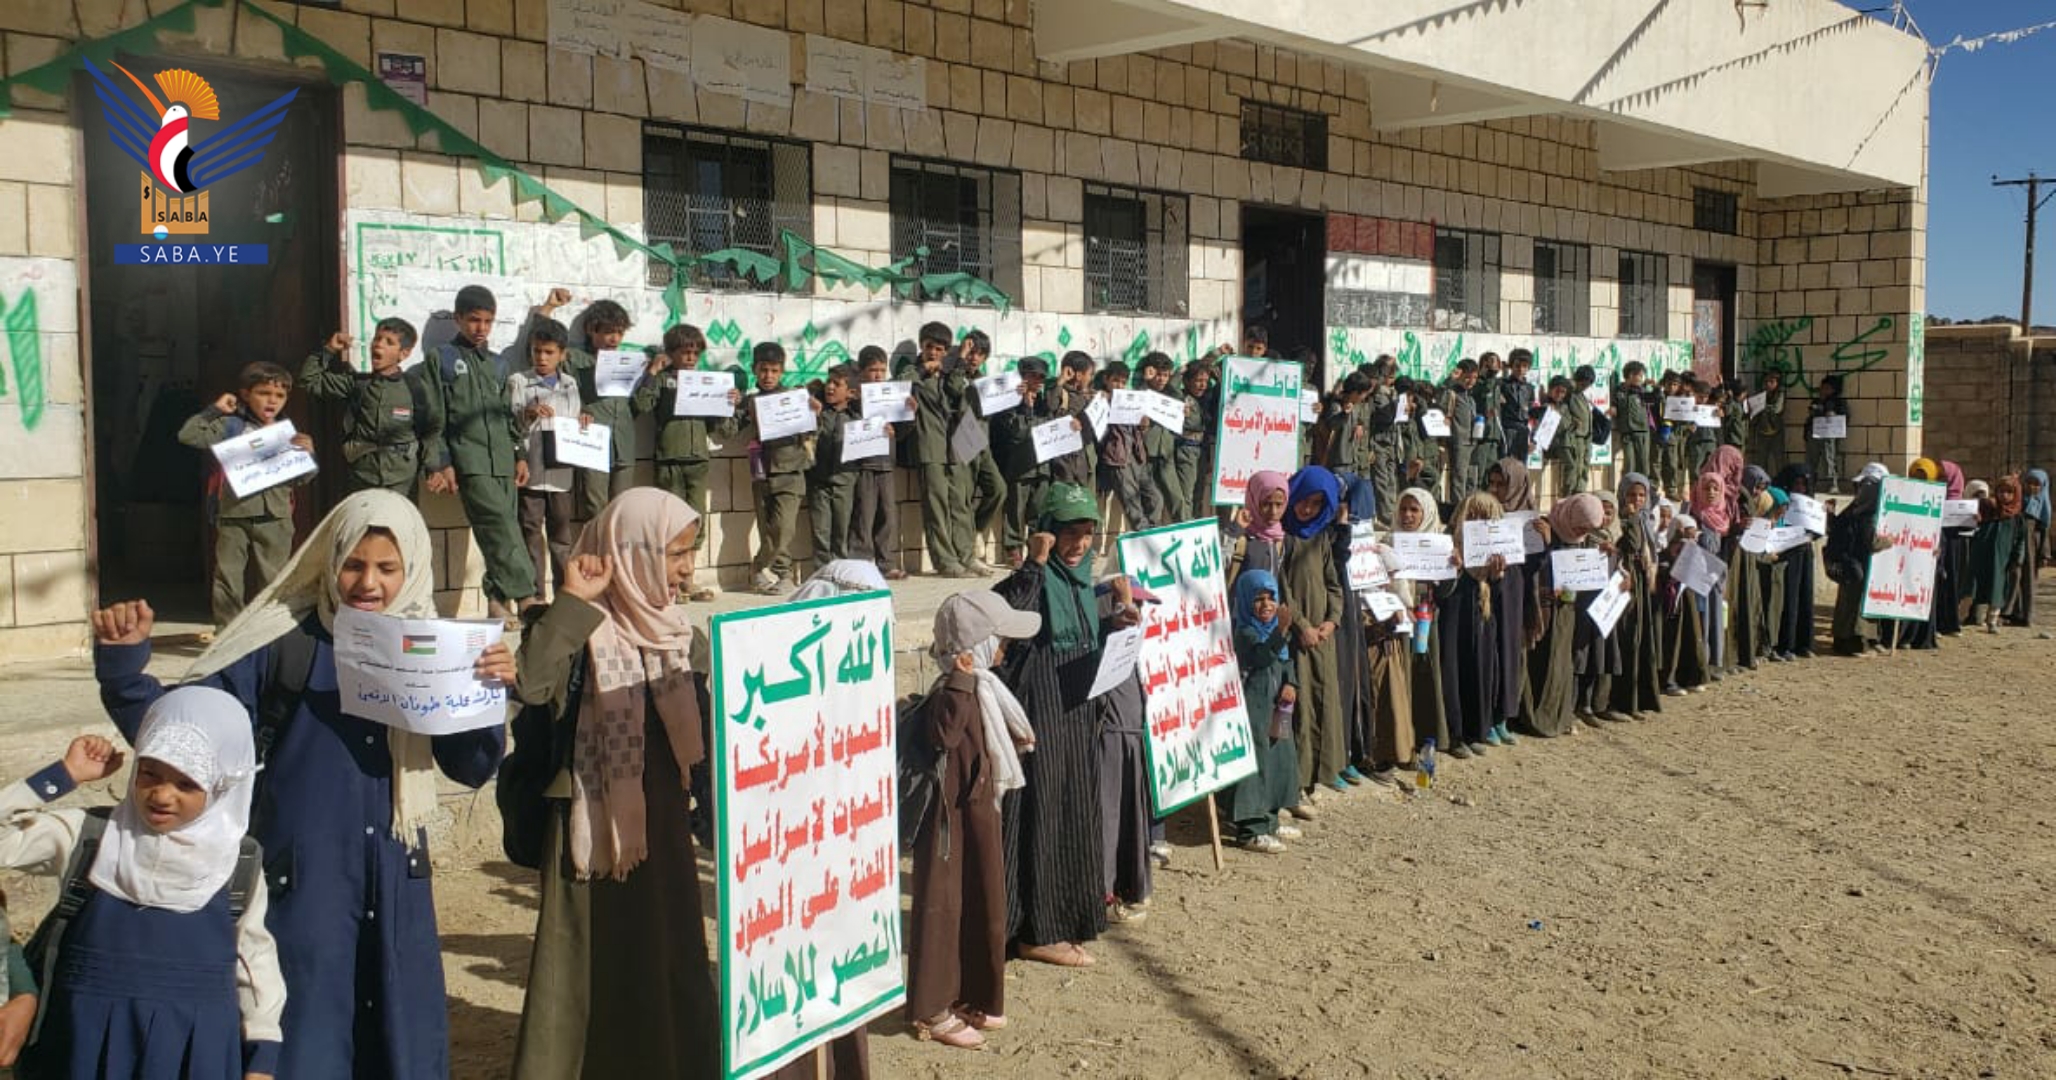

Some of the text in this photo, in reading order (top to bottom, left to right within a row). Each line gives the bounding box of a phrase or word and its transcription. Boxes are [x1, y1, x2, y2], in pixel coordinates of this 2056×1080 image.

[1228, 368, 1298, 402] قاطعوا
[730, 614, 892, 732] الله أكبر
[733, 705, 892, 793] الموت لأمريكا
[735, 777, 893, 883] الموت لإسرائيل
[735, 843, 895, 958] اللعنة على اليهود
[736, 908, 899, 1042] النصر للإسلام
